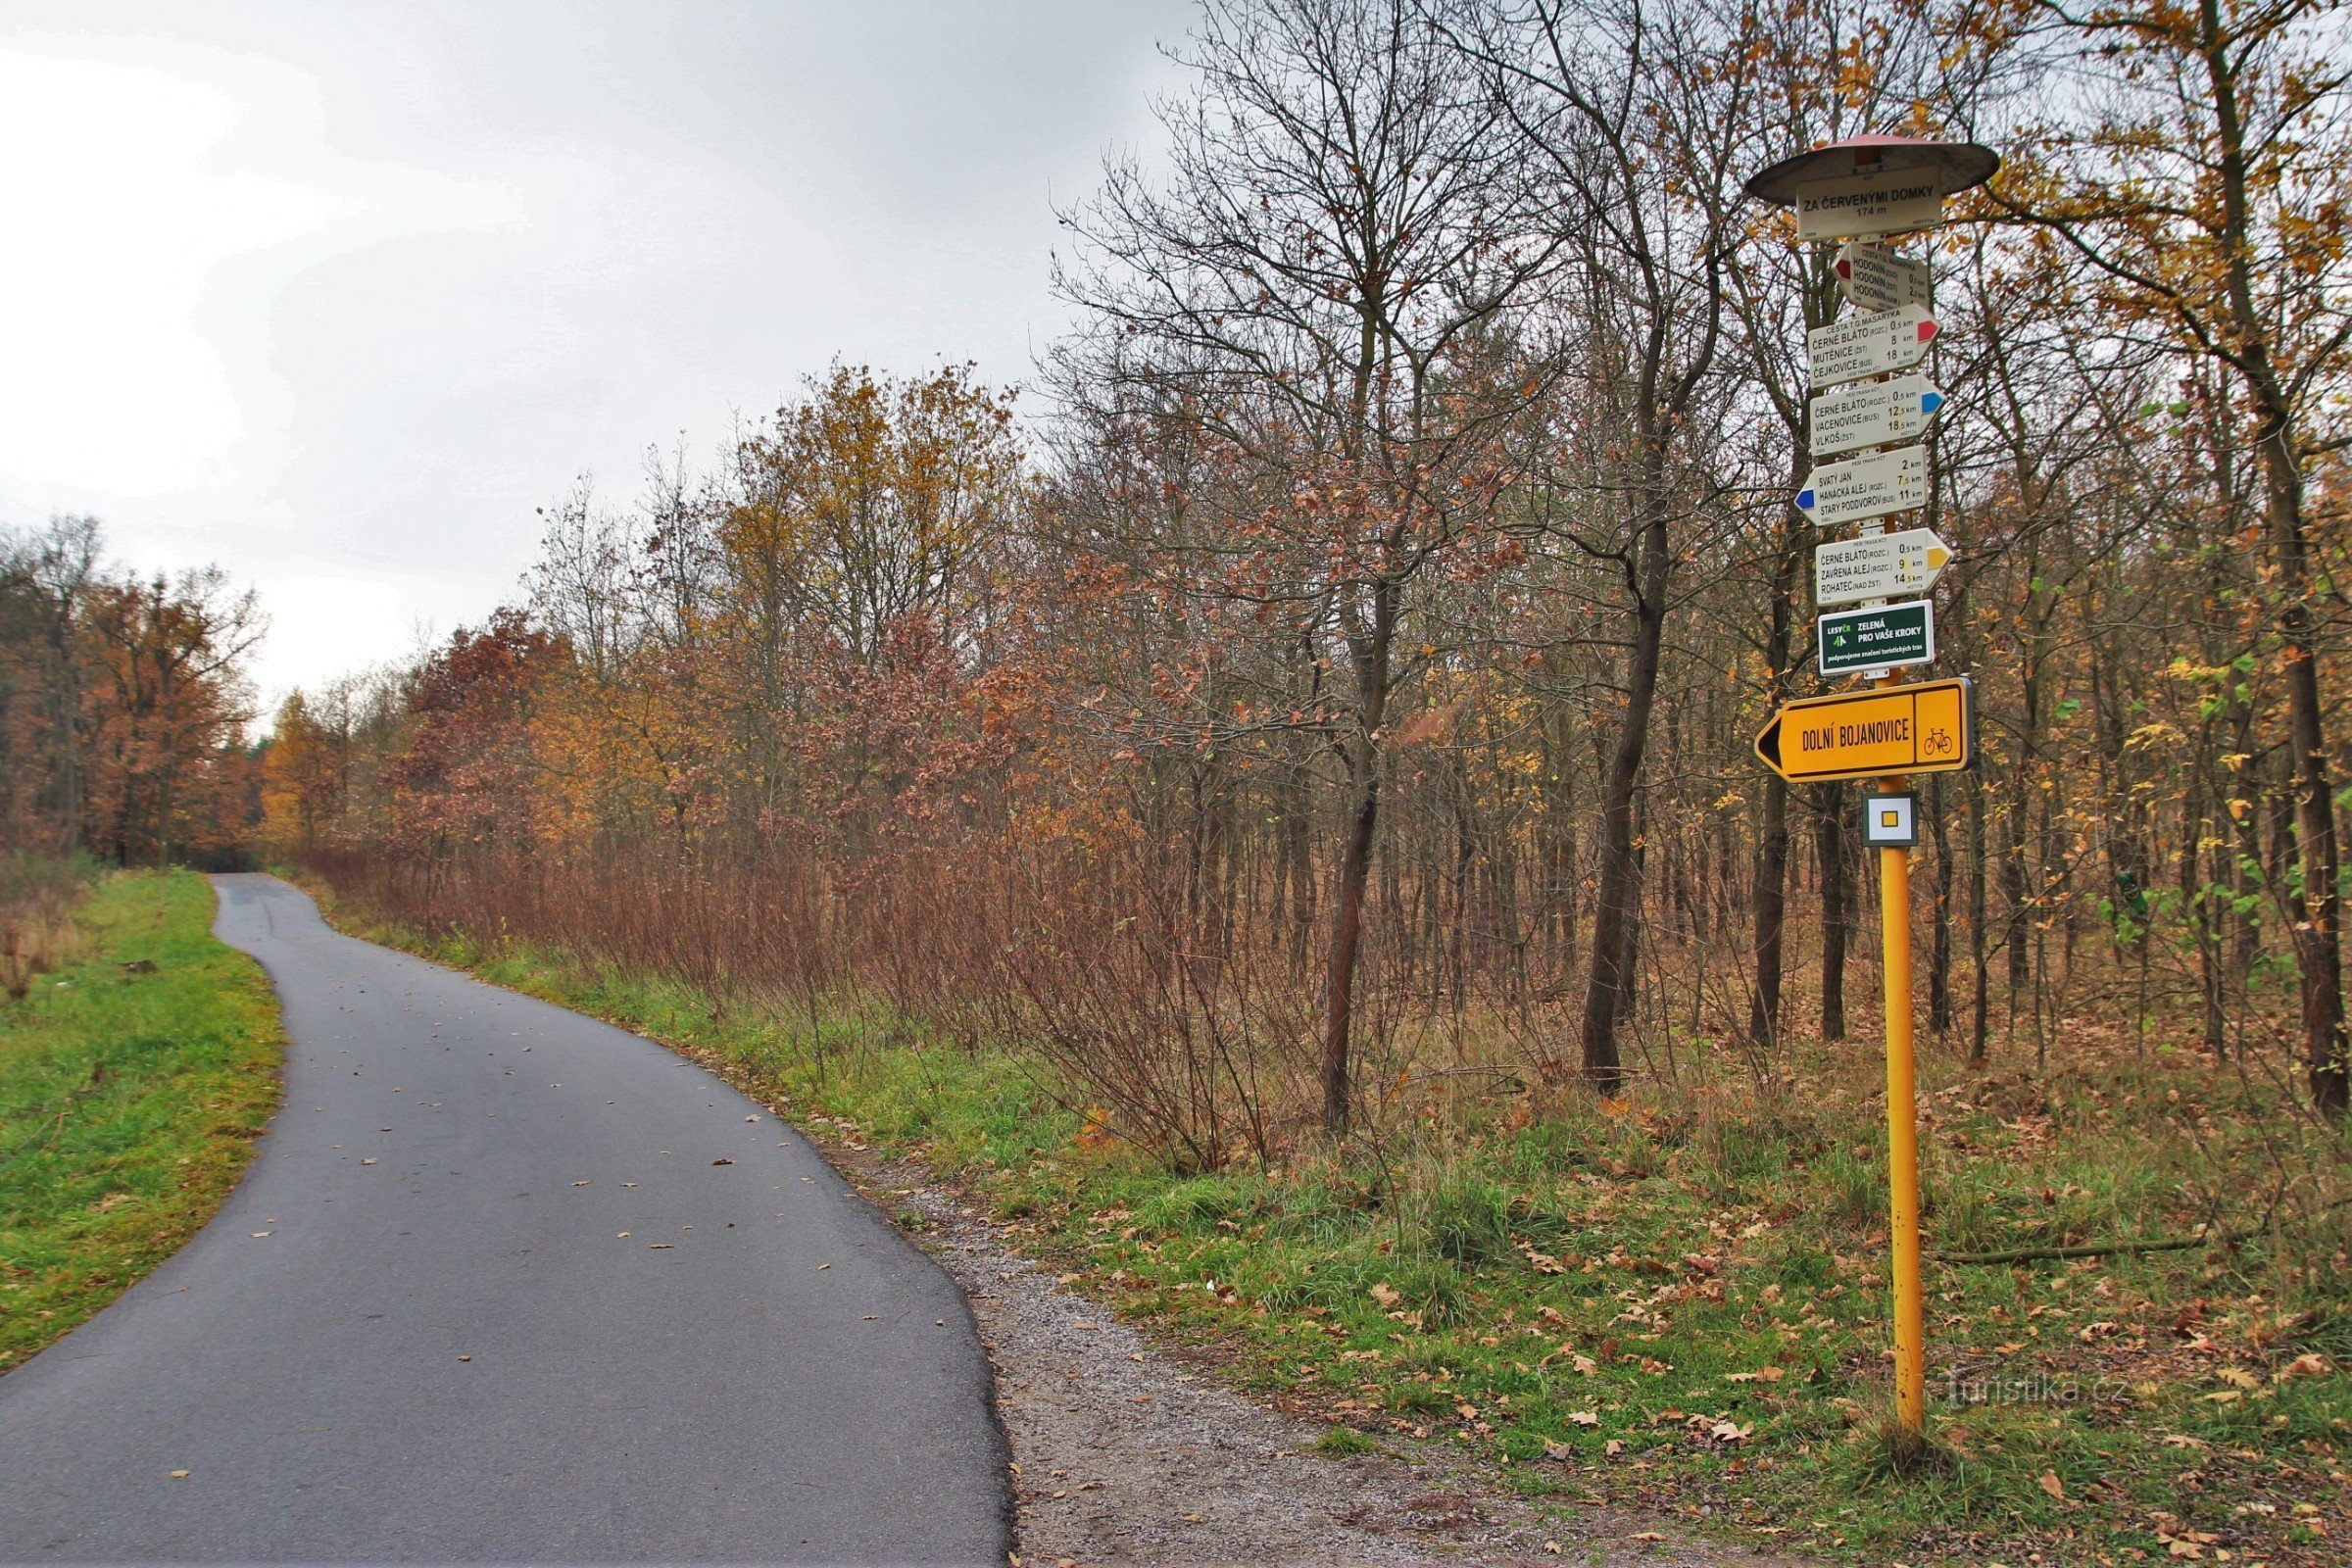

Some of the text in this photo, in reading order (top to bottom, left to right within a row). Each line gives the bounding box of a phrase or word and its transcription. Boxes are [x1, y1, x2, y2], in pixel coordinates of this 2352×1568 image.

[1804, 185, 1934, 212] ZA ČERVENÝMI DOMKY
[1857, 207, 1874, 216] 174
[1853, 257, 1885, 275] HODONÍN
[1862, 249, 1878, 259] CESTA
[1889, 258, 1916, 271] MASARYKA
[1854, 270, 1885, 288] HODONÍN
[1854, 283, 1886, 302] HODONÍN
[1813, 335, 1839, 349] ČERNÉ
[1842, 328, 1868, 343] BLÁTO
[1890, 320, 1901, 331] 0,5
[1827, 323, 1847, 334] CESTA
[1813, 346, 1853, 364] MUTĚNICE
[1854, 345, 1867, 354] (ŽST)
[1891, 335, 1897, 344] 8
[1814, 359, 1857, 378] ČEJKOVICE
[1858, 359, 1872, 368] (BUS)
[1887, 350, 1897, 360] 18
[1815, 403, 1839, 418] ČERNÉ
[1842, 397, 1866, 412] BLÁTO
[1867, 396, 1890, 407] (ROZC.)
[1893, 392, 1904, 401] 0,5
[1815, 414, 1862, 432] VACENOVICE
[1863, 413, 1879, 423] (BUS)
[1888, 407, 1905, 417] 12,5
[1815, 431, 1839, 446] VLKOŠ
[1840, 432, 1855, 441] (ŽST)
[1888, 421, 1905, 431] 18,5
[1903, 460, 1908, 470] 2
[1819, 472, 1852, 487] SVATÝ JAN
[1851, 483, 1866, 494] ALEJ
[1869, 482, 1887, 491] (ROZC.)
[1898, 475, 1909, 485] 7,5
[1820, 500, 1840, 515] STARÝ
[1842, 495, 1881, 511] PODDVOROV
[1882, 495, 1896, 504] (BUS)
[1899, 490, 1909, 500] 11
[1821, 551, 1843, 565] ČERNÉ
[1845, 548, 1867, 562] BLÁTO
[1868, 549, 1889, 560] (ROZC.)
[1899, 544, 1911, 554] 0,5
[1821, 564, 1852, 581] ZAVŘENÁ
[1853, 564, 1870, 576] ALEJ
[1871, 564, 1892, 574] (ROZC.)
[1899, 560, 1905, 569] 9
[1821, 581, 1853, 594] ROHATEC
[1853, 581, 1867, 591] (NAD
[1868, 579, 1881, 589] ŽST)
[1894, 574, 1911, 584] 14,5
[1858, 618, 1886, 632] ZELENÁ
[1858, 626, 1921, 643] PRO VAŠE KROKY
[1828, 652, 1861, 663] podporujeme
[1862, 648, 1881, 657] značení
[1882, 644, 1911, 654] turistických
[1803, 718, 1909, 752] DOLNÍ BOJANOVICE
